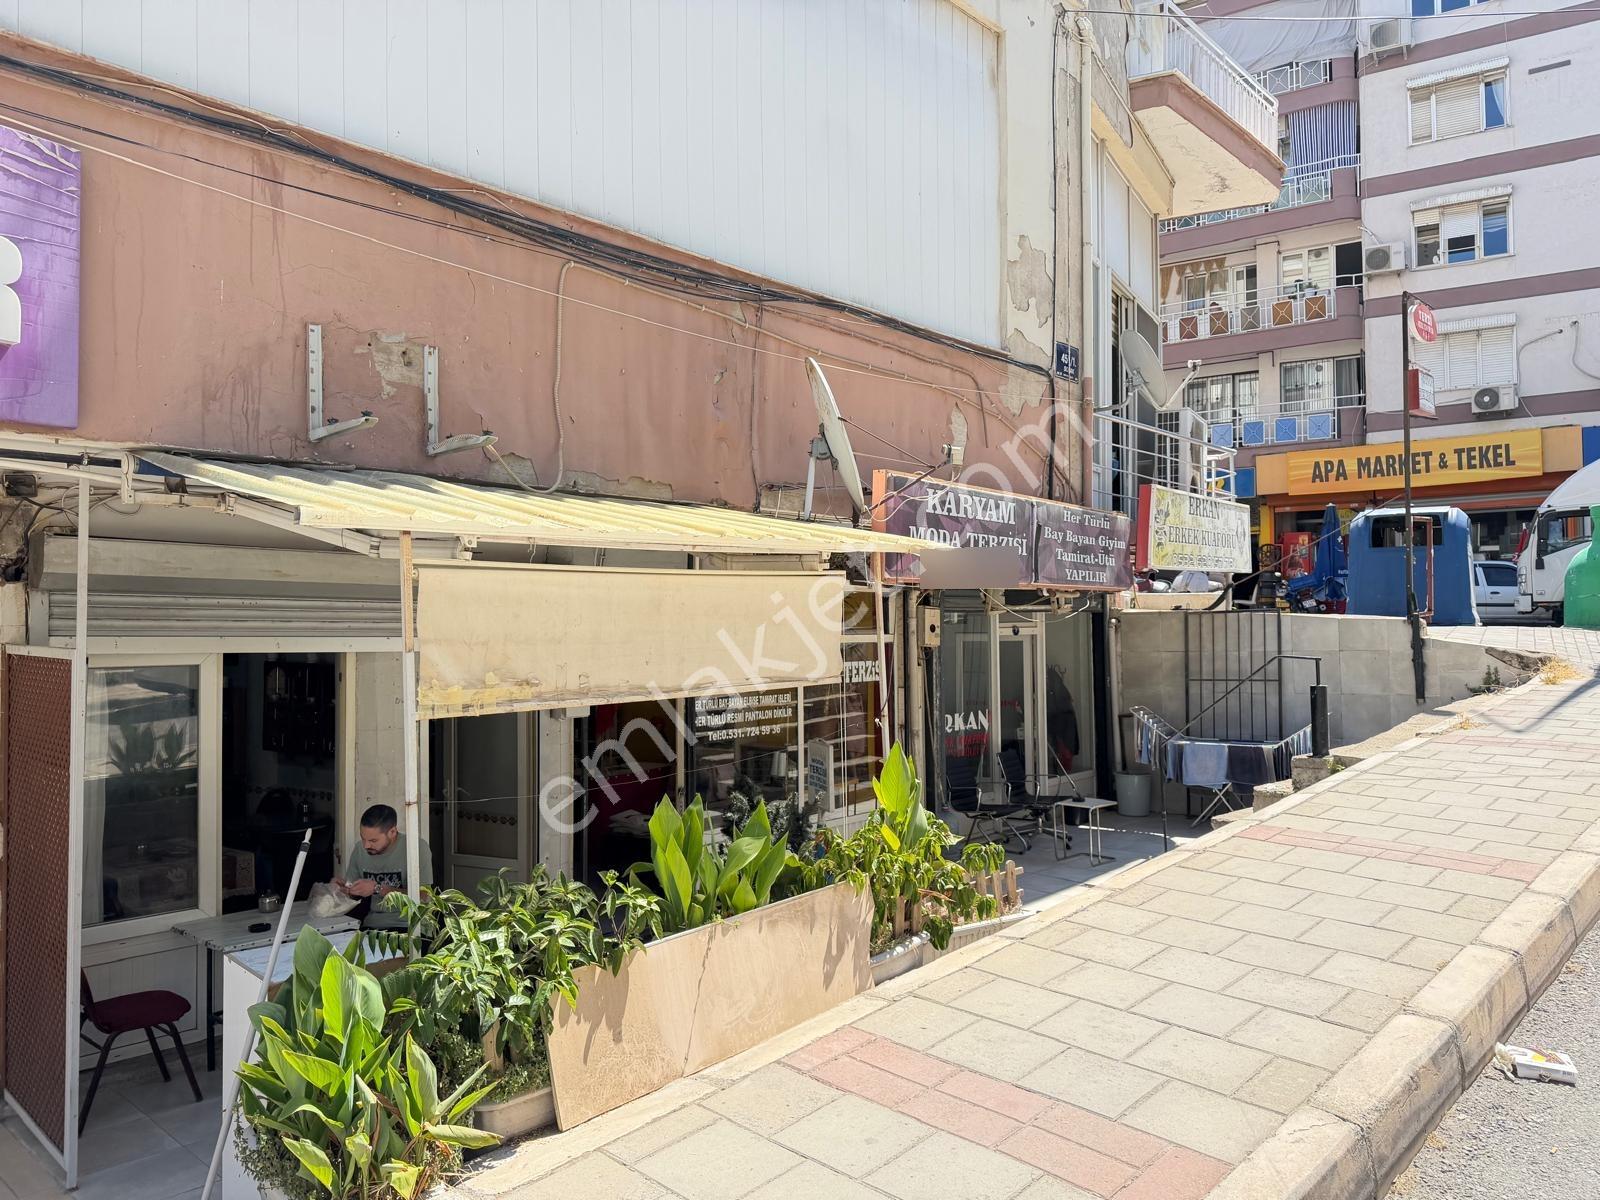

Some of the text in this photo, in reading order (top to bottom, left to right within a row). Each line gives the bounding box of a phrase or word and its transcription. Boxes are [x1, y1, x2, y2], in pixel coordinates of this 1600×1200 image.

[1311, 443, 1516, 484] APA MARKET & TEKEL
[926, 487, 1017, 525] KARYAM
[1189, 496, 1220, 520] ERKAN
[1063, 510, 1110, 529] Her Türlü
[909, 525, 961, 549] MODA
[1044, 526, 1126, 550] Bay Bayan Giyim
[1168, 526, 1199, 545] ERKEK
[1056, 548, 1115, 566] Tamirat-Ütü
[1065, 568, 1107, 582] YAPILIR
[707, 712, 726, 726] TÜRLÜ
[745, 709, 772, 722] PANTALON
[746, 726, 760, 737] 724
